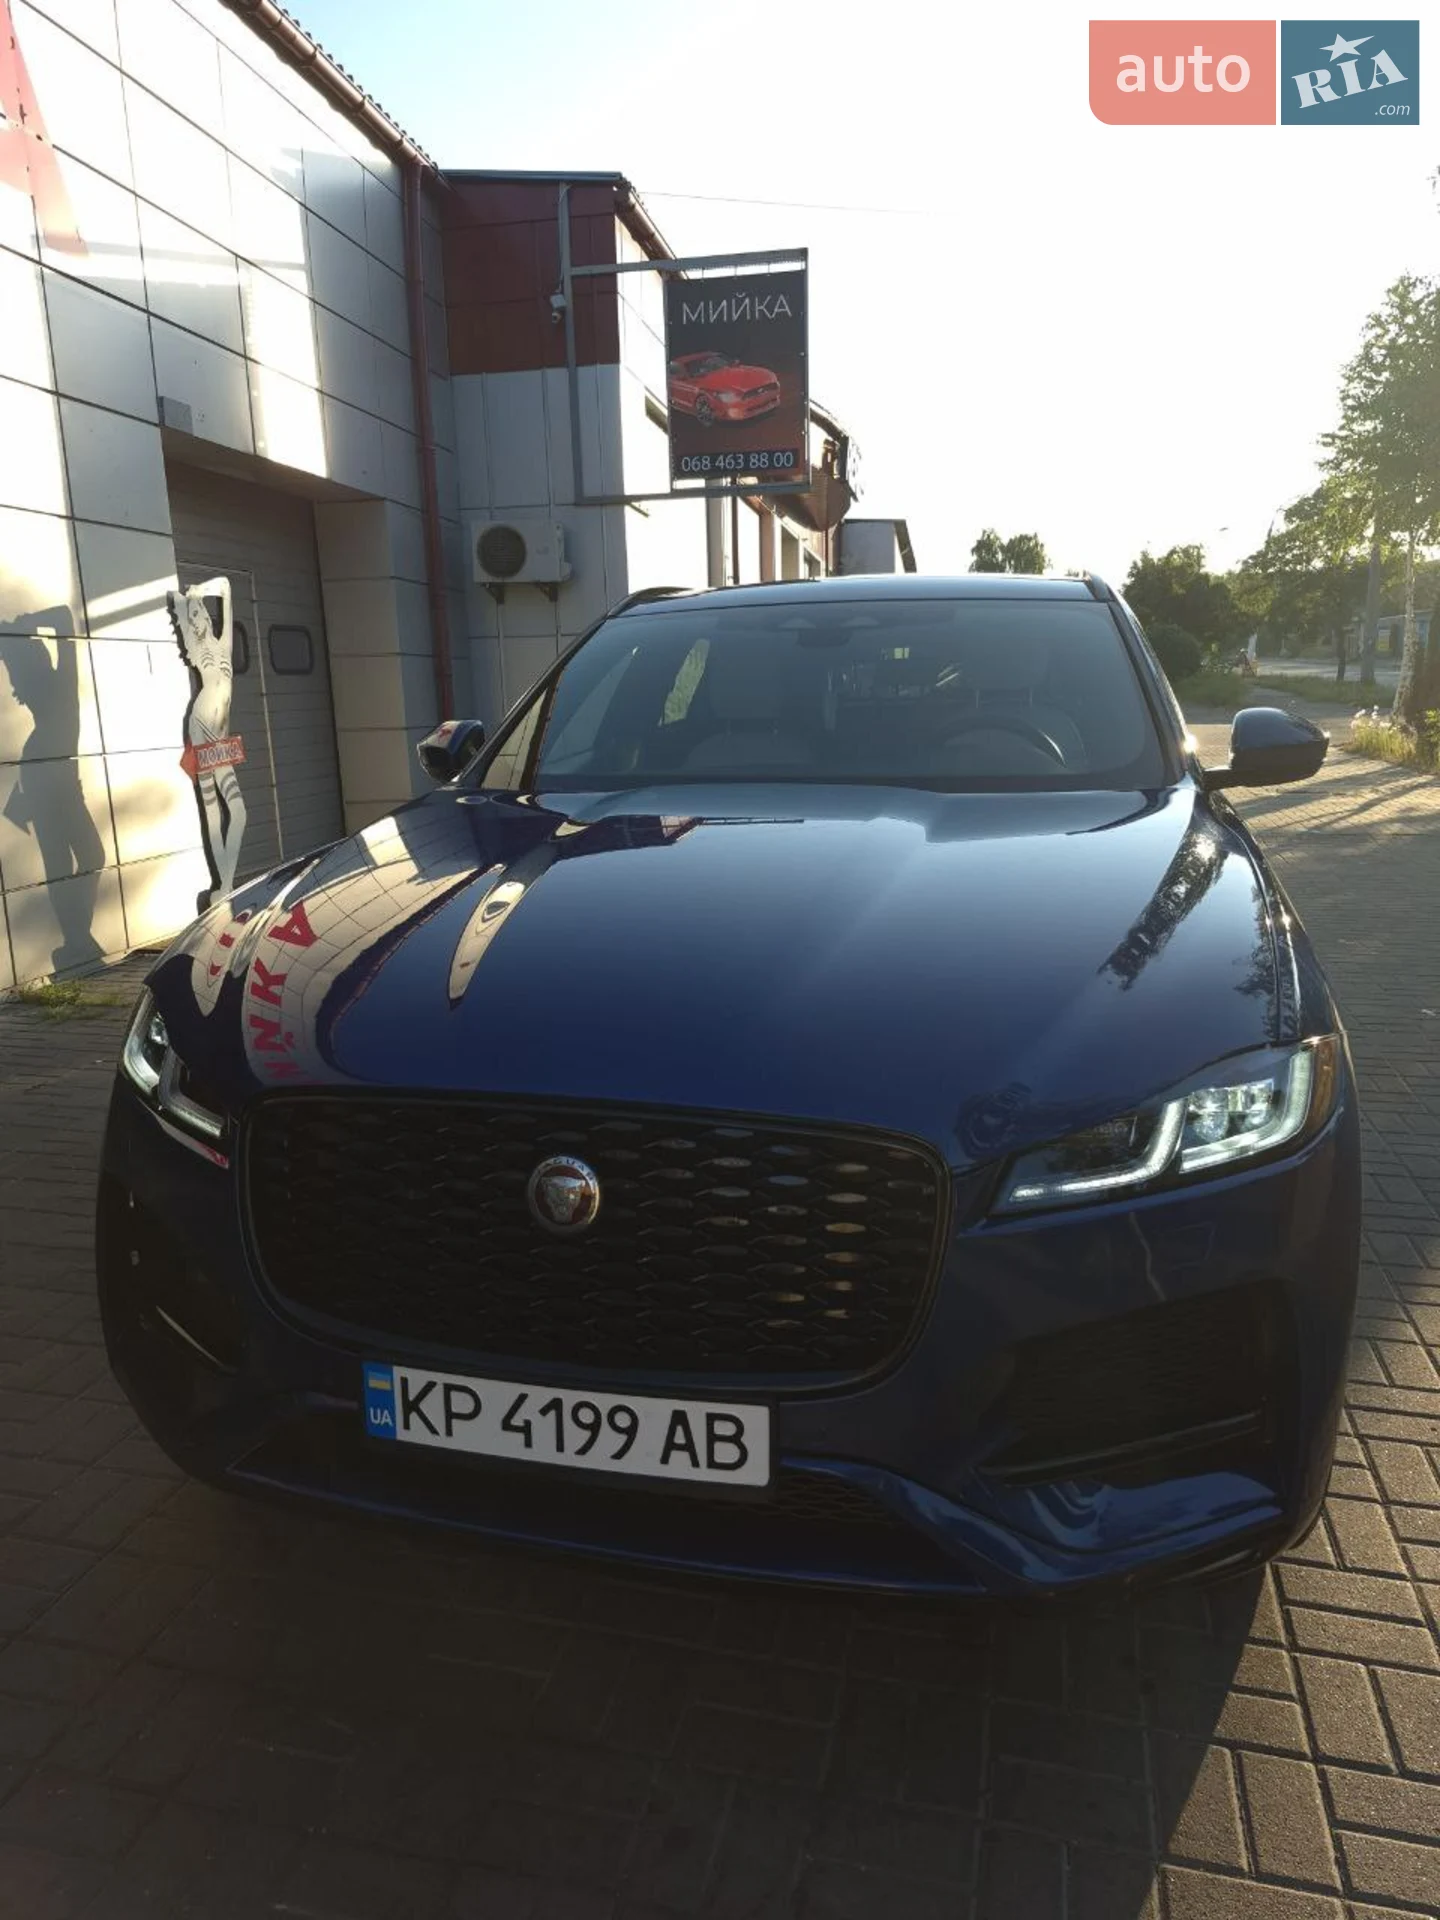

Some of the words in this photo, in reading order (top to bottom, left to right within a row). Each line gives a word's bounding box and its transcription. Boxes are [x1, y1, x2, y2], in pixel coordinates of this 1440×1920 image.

[682, 292, 792, 325] МИЙКА
[682, 455, 711, 472] 068
[715, 454, 744, 470] 463
[750, 452, 769, 469] 88
[773, 451, 793, 468] 00
[369, 1408, 394, 1427] UA
[399, 1375, 482, 1438] KP
[500, 1392, 640, 1461] 4199
[658, 1409, 749, 1471] AB
